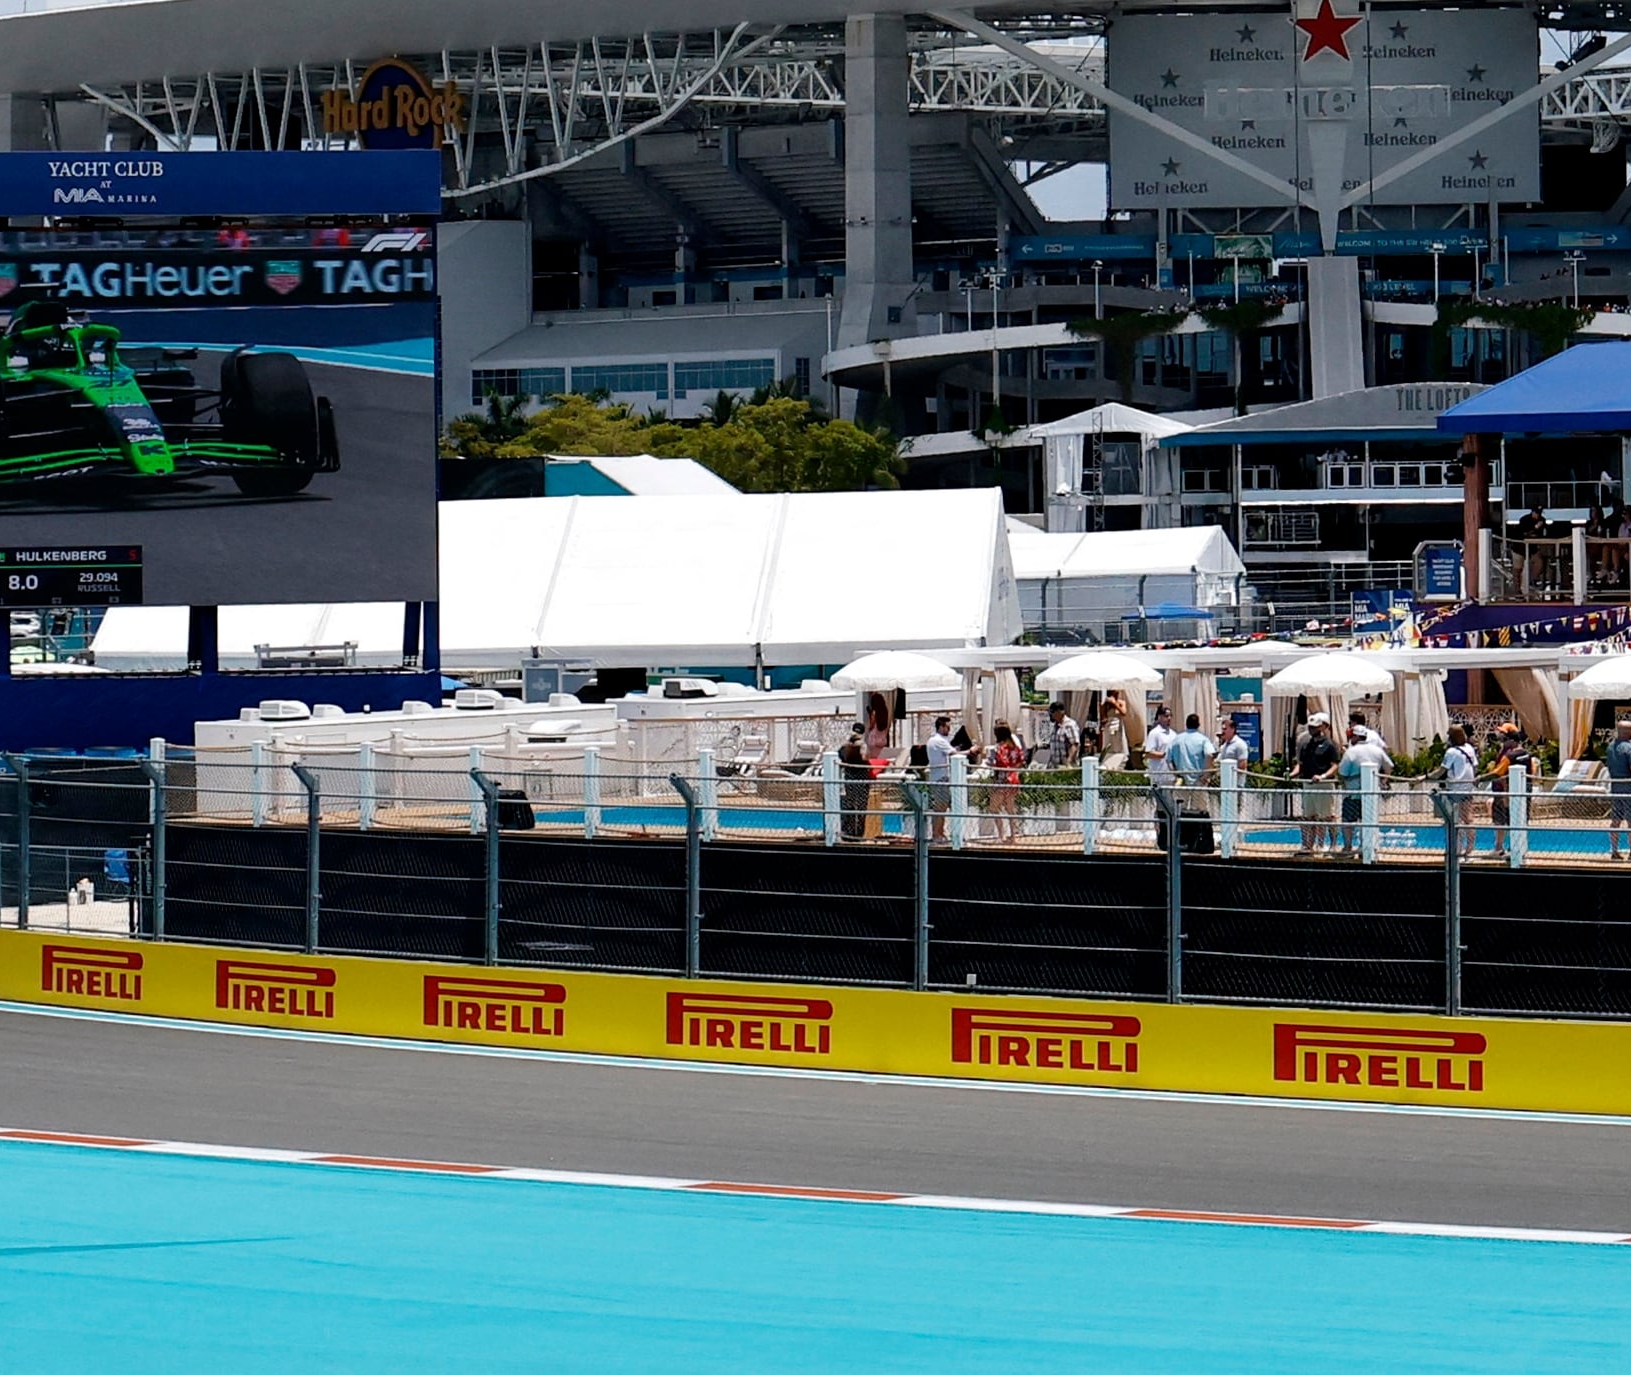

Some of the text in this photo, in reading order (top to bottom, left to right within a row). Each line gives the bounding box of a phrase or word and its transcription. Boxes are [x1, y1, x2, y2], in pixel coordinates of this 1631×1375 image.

[1444, 88, 1515, 102] eineken
[321, 80, 468, 136] Hard Rock
[48, 161, 164, 177] YACHT CLUB
[100, 180, 112, 189] AT
[54, 188, 157, 203] MIA MARINA
[1396, 388, 1422, 411] THE
[16, 551, 107, 562] HULKENBERG
[8, 573, 119, 590] 8.0 29.094
[77, 584, 121, 593] RUSSELL
[41, 942, 144, 1001] PIRELLI
[215, 958, 337, 1020] PIRELLI
[422, 974, 568, 1037] PIRELLI
[666, 990, 834, 1055] PIRELLI
[951, 1005, 1142, 1073] PIRELLI
[1273, 1022, 1488, 1093] PIRELLI
